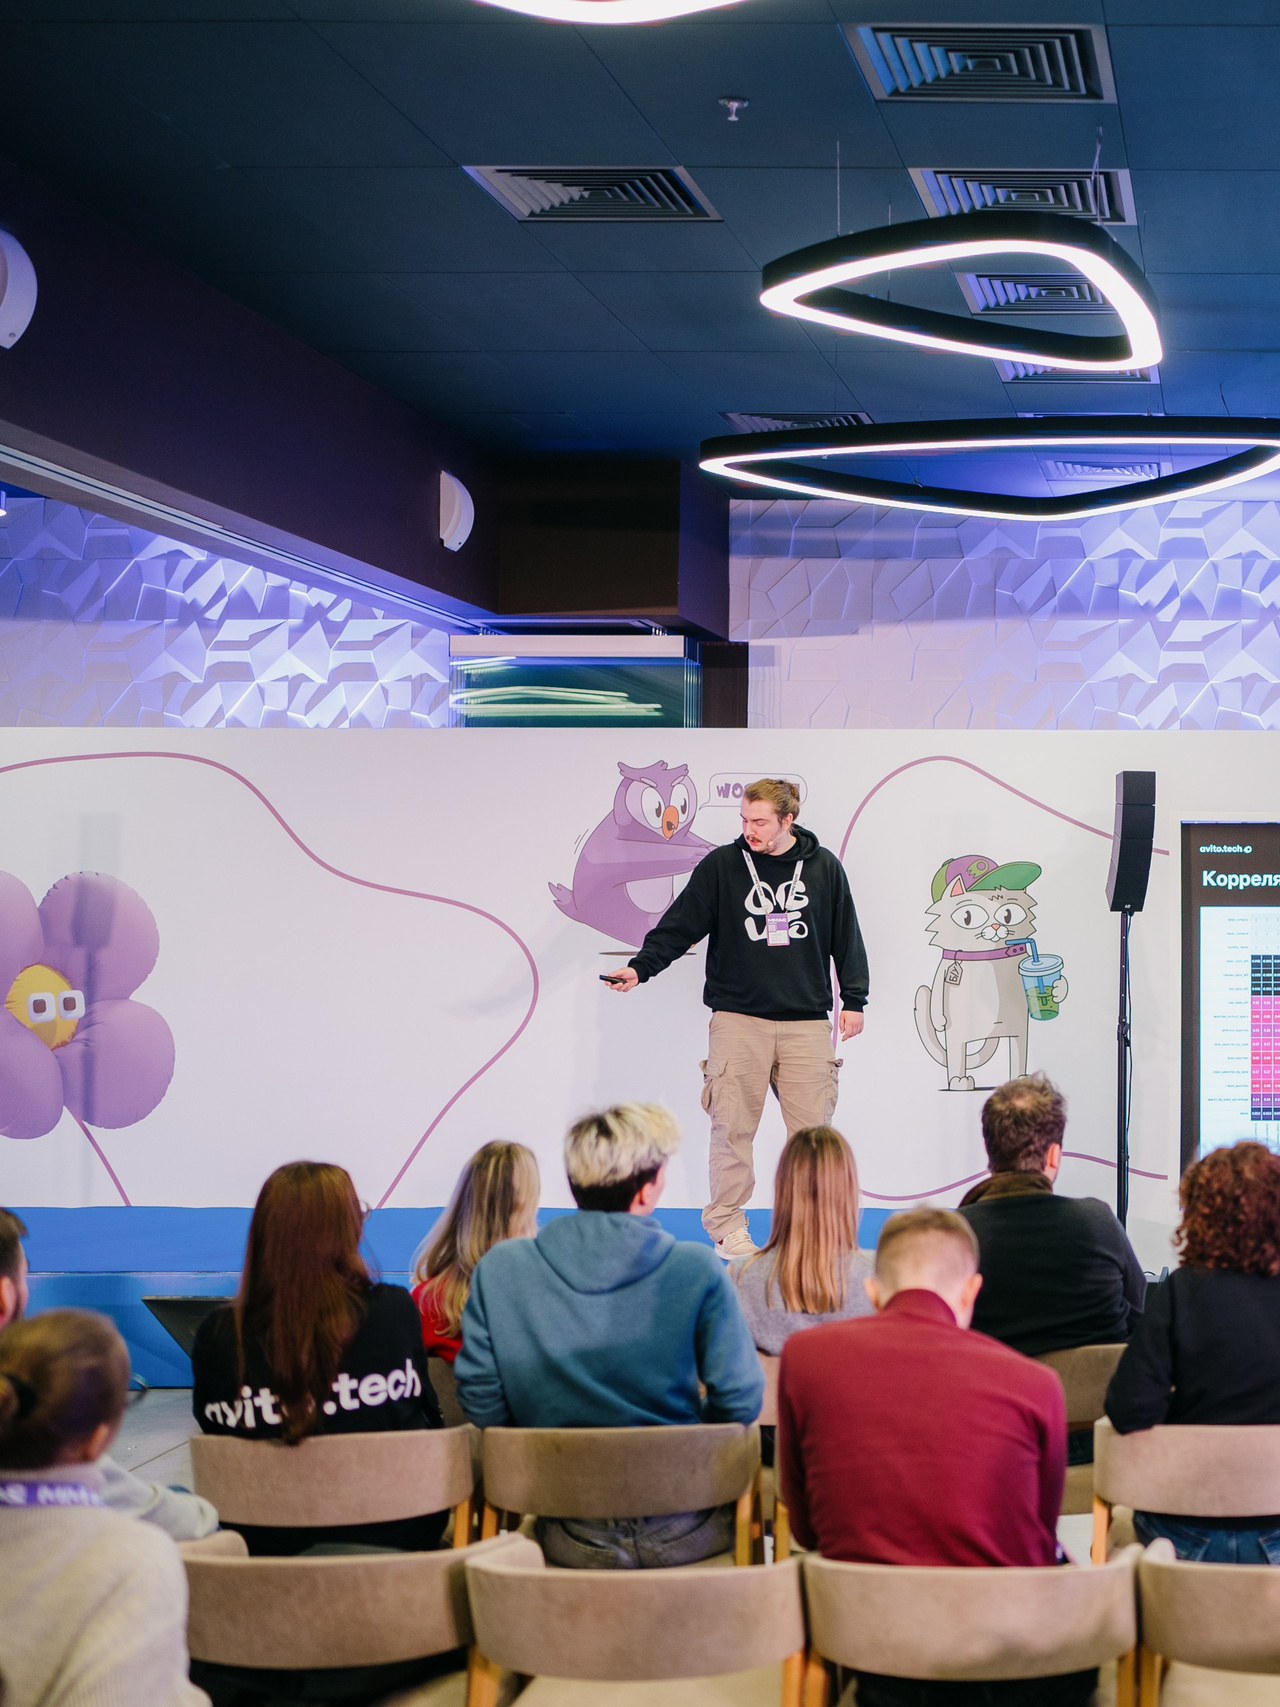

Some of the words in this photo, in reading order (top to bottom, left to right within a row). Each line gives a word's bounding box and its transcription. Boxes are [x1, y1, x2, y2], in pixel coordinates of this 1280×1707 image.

[1199, 844, 1243, 854] avito.tech
[949, 966, 960, 982] Б/У
[204, 1358, 422, 1428] avit.tech
